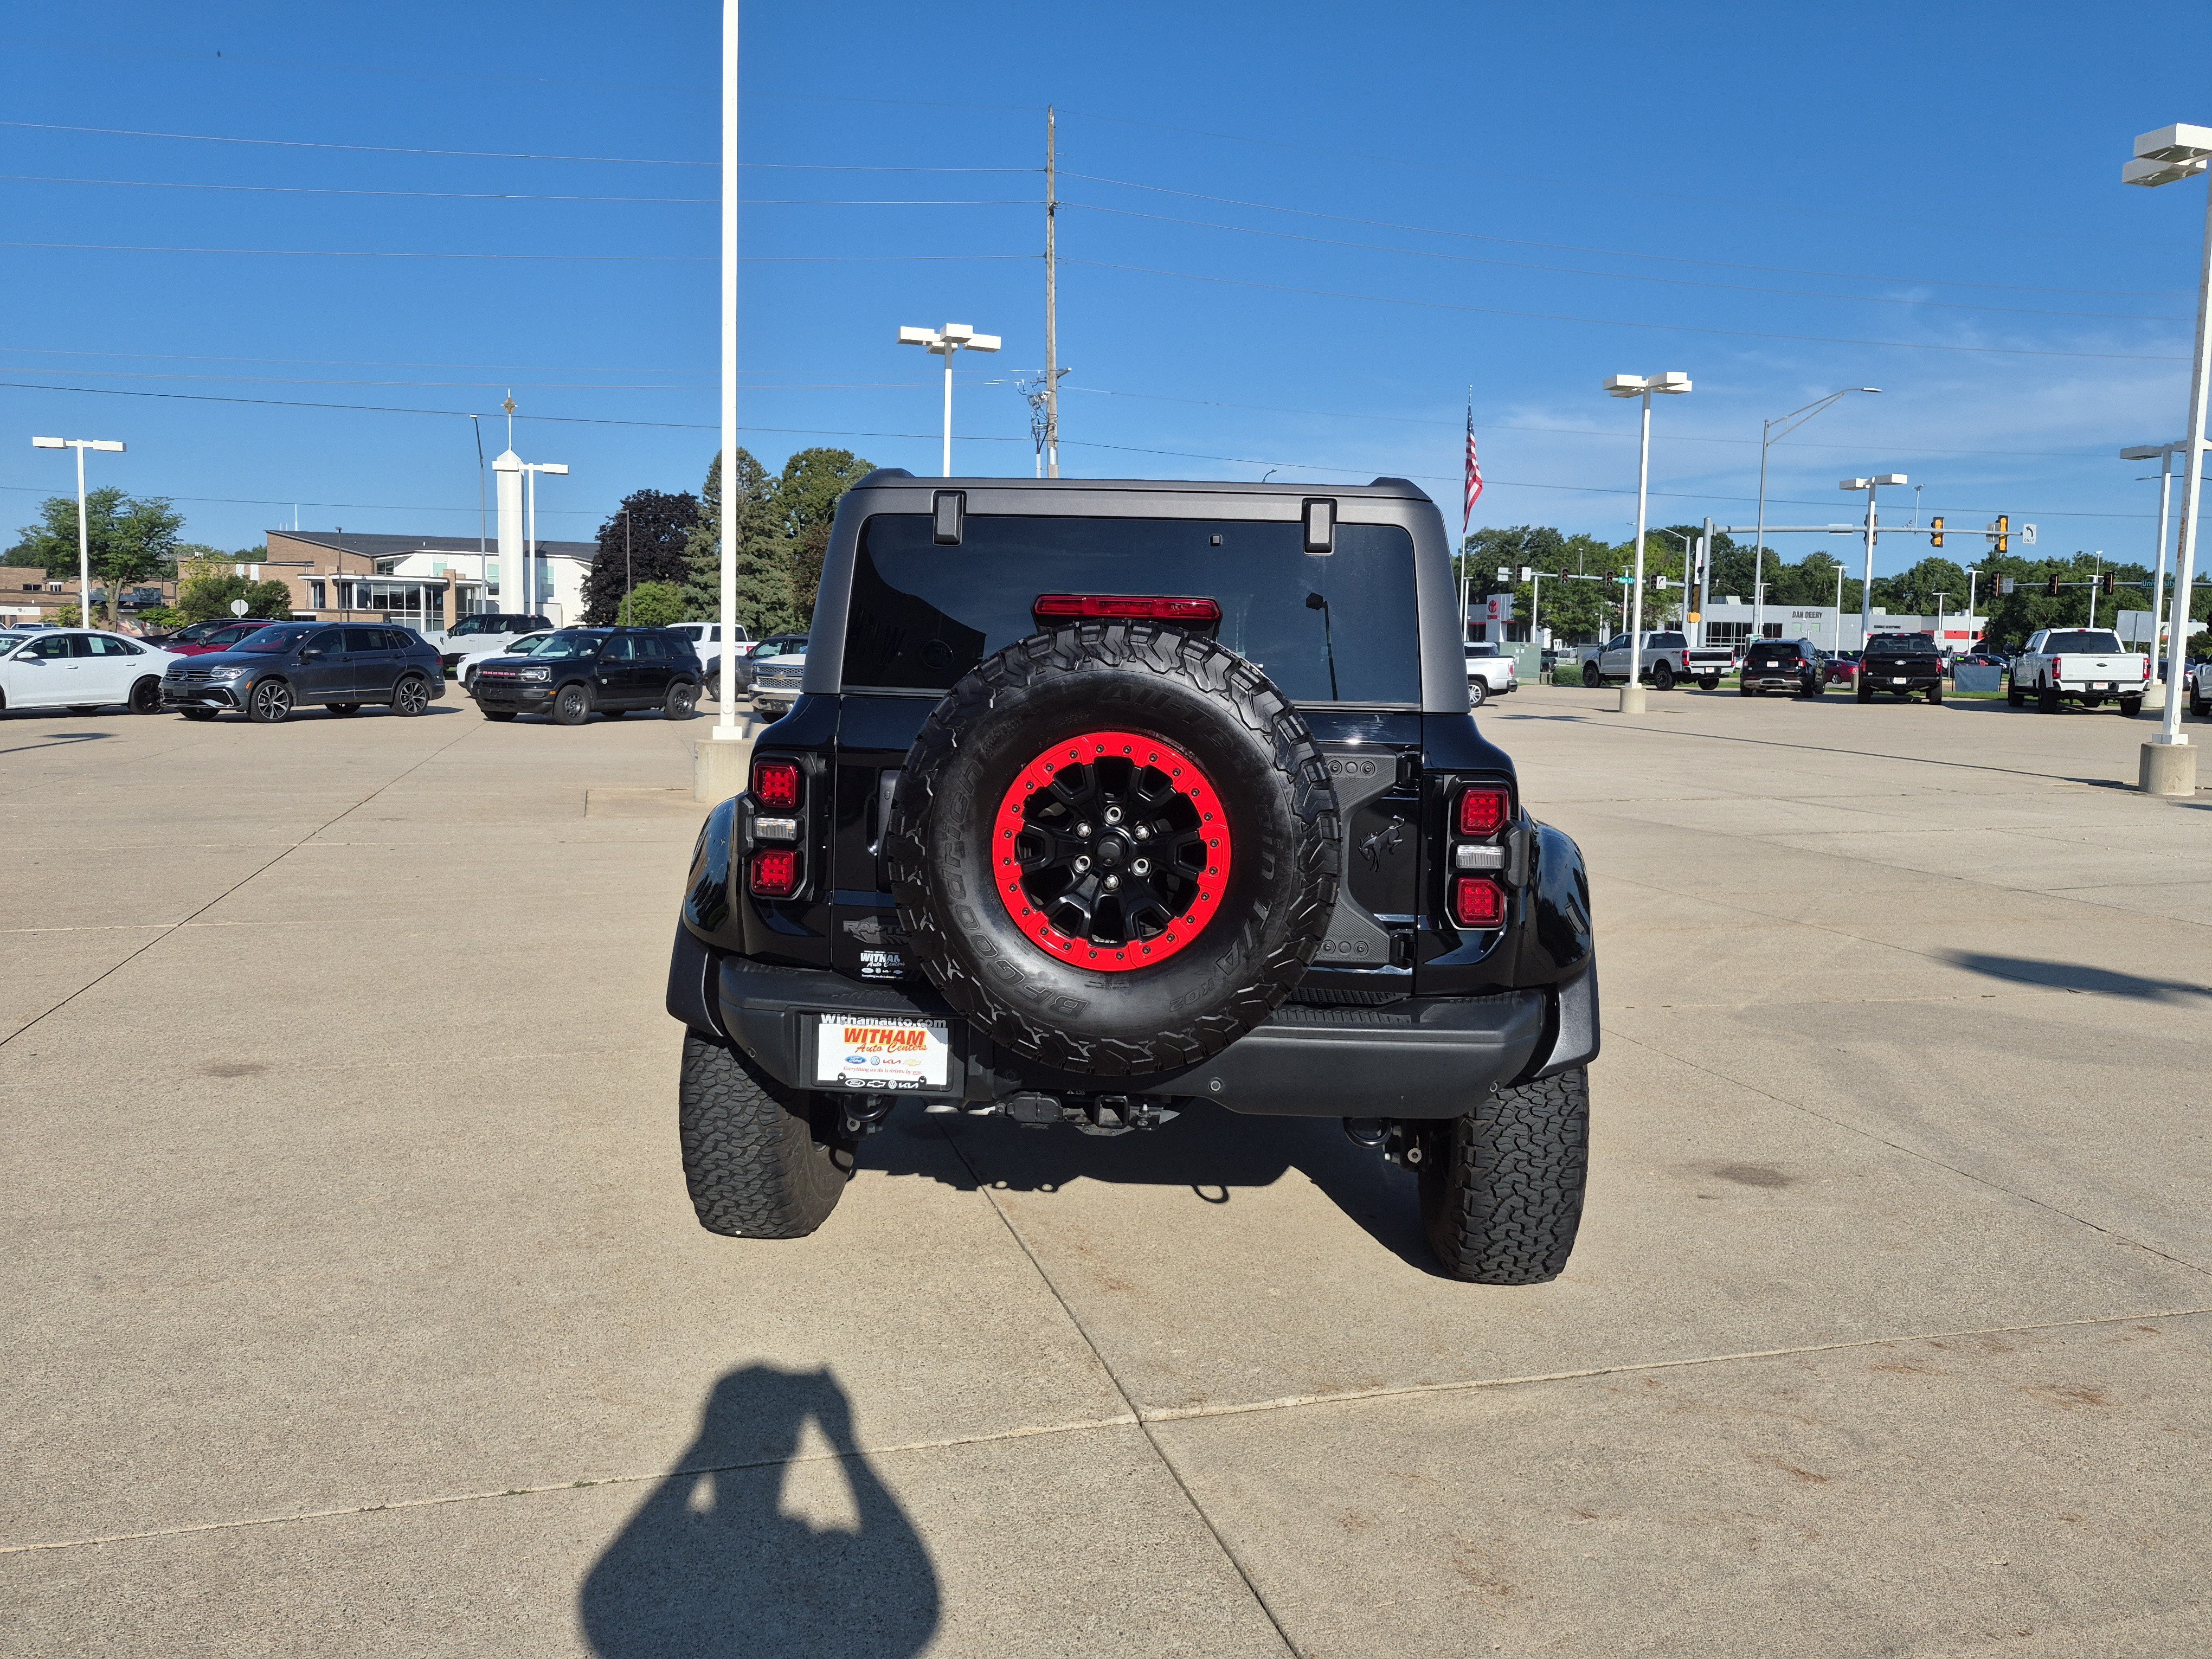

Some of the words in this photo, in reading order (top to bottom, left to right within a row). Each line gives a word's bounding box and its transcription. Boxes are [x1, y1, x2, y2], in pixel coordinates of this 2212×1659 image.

[940, 760, 1089, 1019] BFGoodrich
[860, 953, 900, 963] WITHAM
[821, 1013, 947, 1028] Withamauto.com
[844, 1027, 925, 1045] WITHAM
[855, 1043, 883, 1053] Auto
[887, 1041, 928, 1053] Centers
